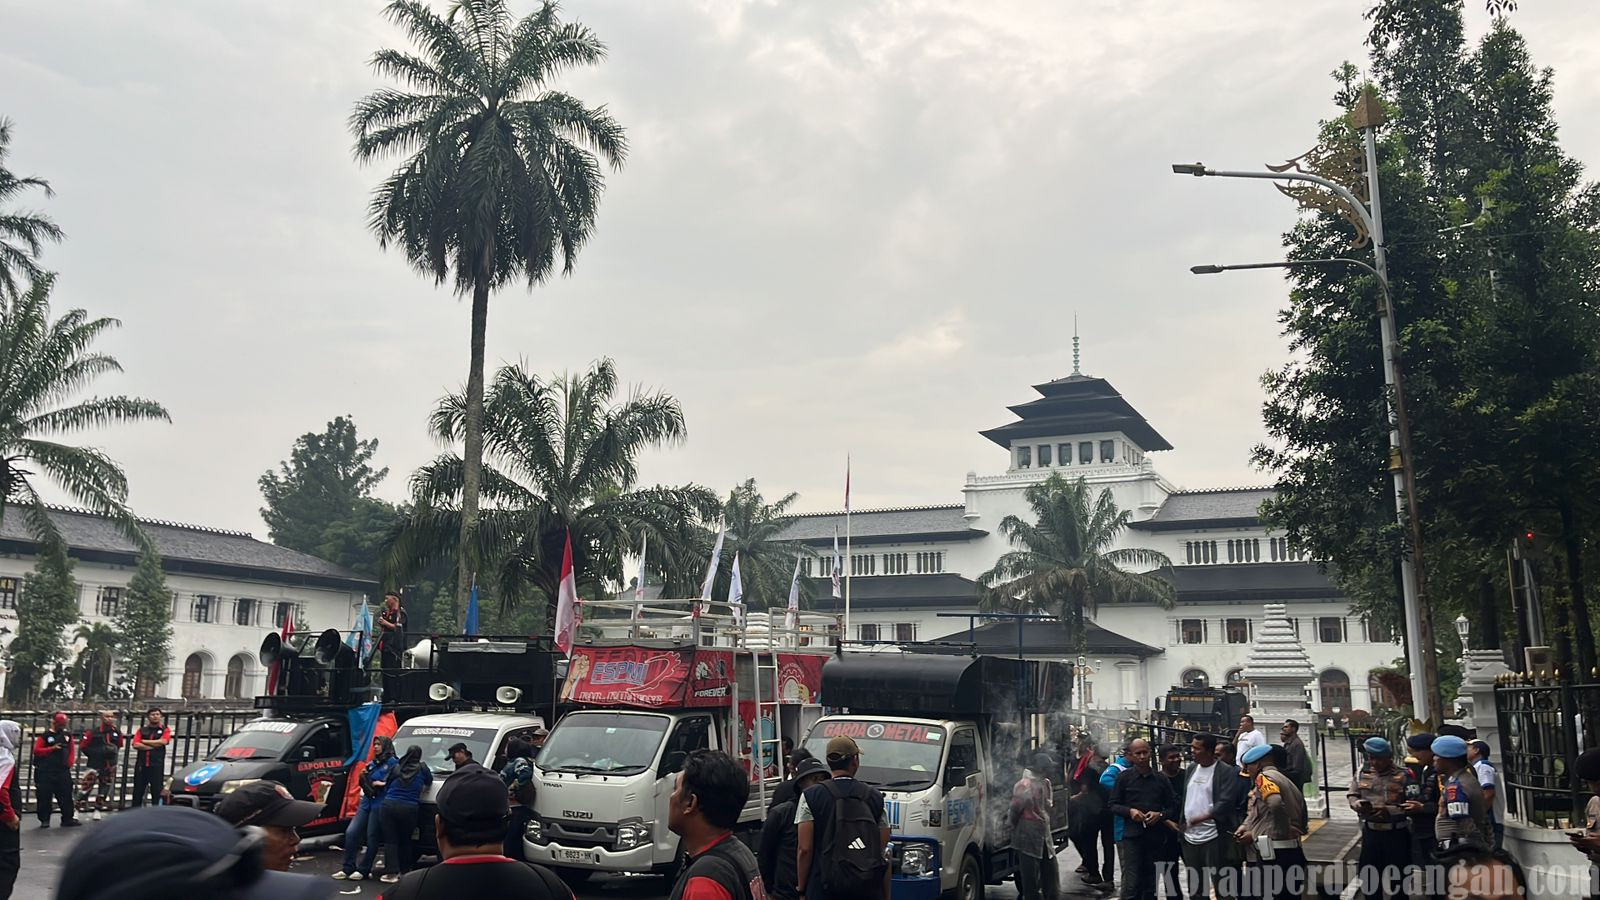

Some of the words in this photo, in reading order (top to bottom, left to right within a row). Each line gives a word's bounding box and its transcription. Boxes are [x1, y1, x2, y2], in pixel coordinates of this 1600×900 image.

[694, 687, 726, 697] FOREVER
[823, 722, 867, 737] GARDA
[883, 724, 929, 742] METAL
[563, 810, 593, 819] ISUZU
